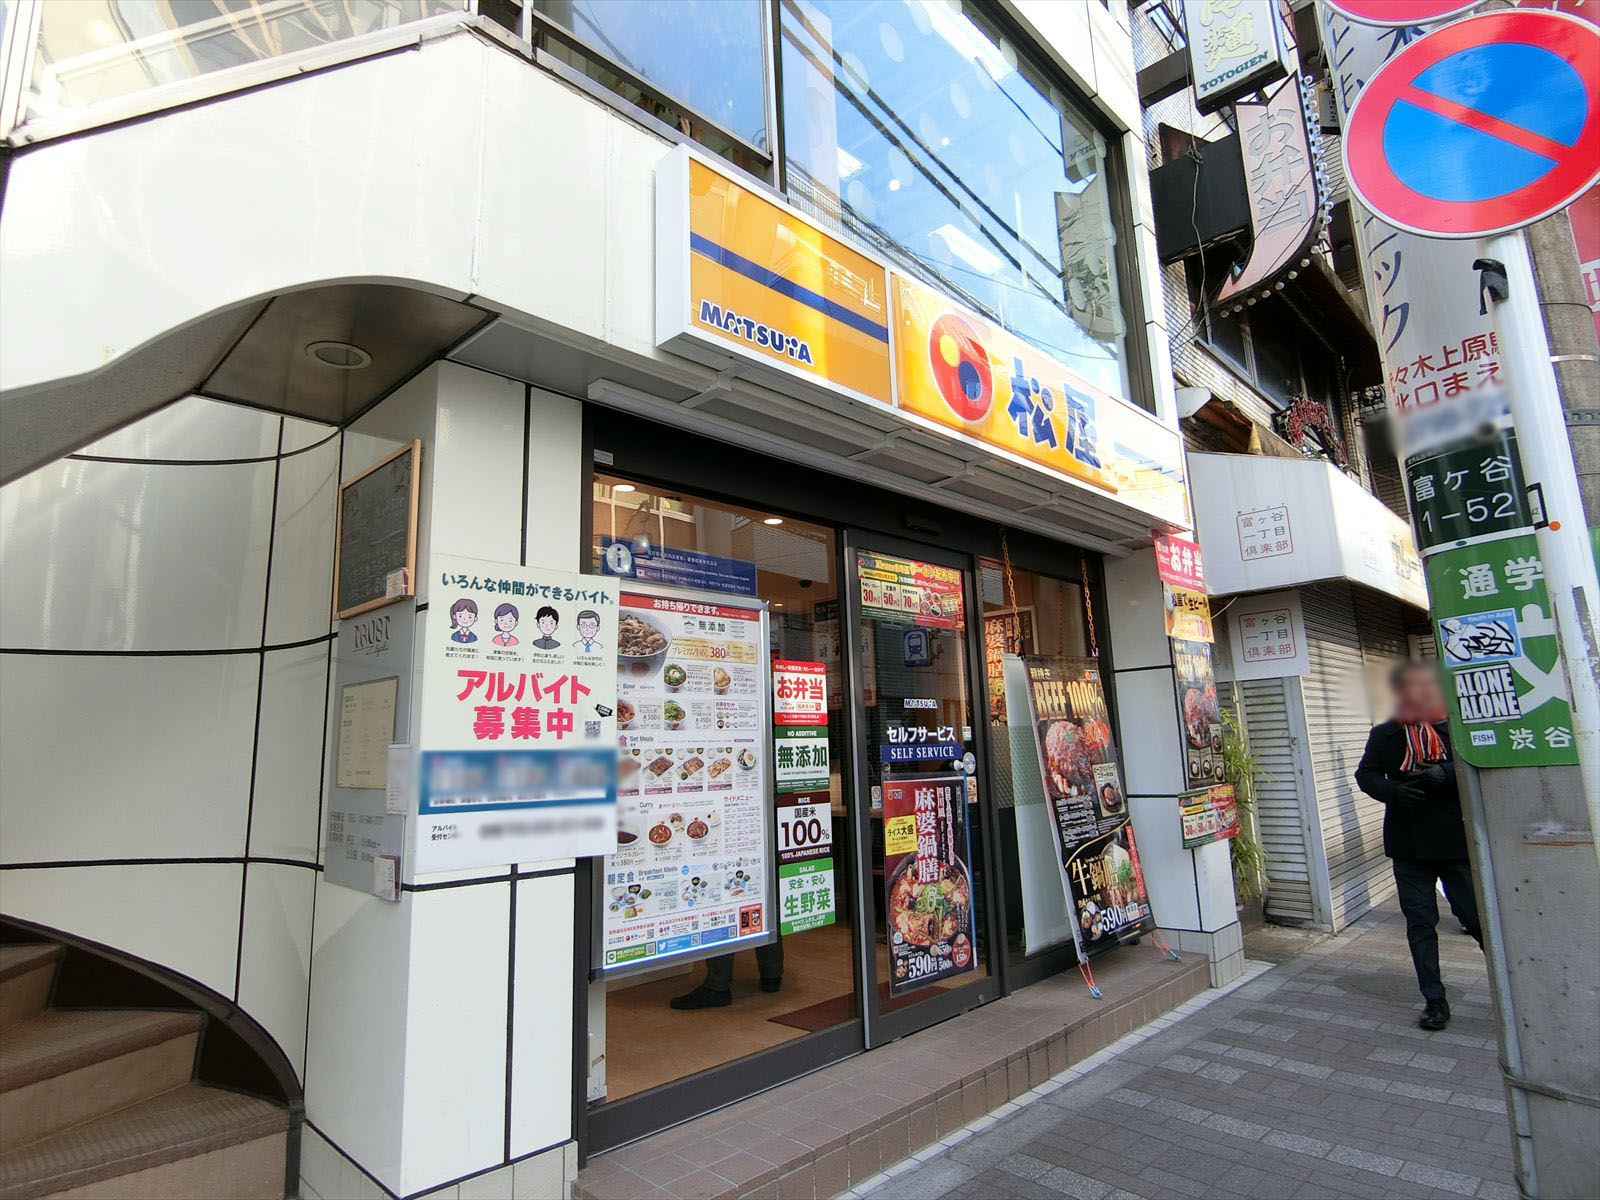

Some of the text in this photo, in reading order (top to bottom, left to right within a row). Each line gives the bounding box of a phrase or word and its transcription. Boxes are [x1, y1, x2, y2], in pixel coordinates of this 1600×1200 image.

[1200, 51, 1269, 92] YOYOGIEN
[1247, 108, 1311, 237] お弁当
[700, 299, 813, 365] MATSUYA
[1007, 356, 1102, 469] 松屋
[1422, 491, 1517, 533] 1-52
[1243, 525, 1286, 540] 一丁目
[1170, 542, 1204, 580] お弁当
[442, 572, 615, 606] いろんな仲間ができるバイト。
[1459, 555, 1545, 600] 通学
[653, 599, 720, 616] お持ち帰りできます。
[1245, 628, 1289, 641] 一丁目
[456, 670, 592, 705] アルバイト
[777, 676, 824, 700] お弁当
[1456, 668, 1515, 697] ALONE
[1033, 681, 1105, 720] BEEF 100%
[1460, 693, 1521, 720] ALONE
[473, 706, 574, 741] 募集中
[887, 726, 956, 743] セルフサービス
[1473, 733, 1494, 743] FISH
[1509, 726, 1572, 750] 渋谷
[777, 744, 828, 768] 無添加
[891, 746, 954, 759] SELF SERVICE
[794, 807, 817, 818] 国産米
[781, 818, 830, 848] 100%
[915, 787, 940, 885] 麻婆鍋膳
[795, 848, 819, 858] JAPANESE
[819, 846, 830, 854] RICE
[608, 871, 634, 885] 朝定食
[789, 874, 826, 891] 安全・安心
[784, 887, 831, 918] 生野菜
